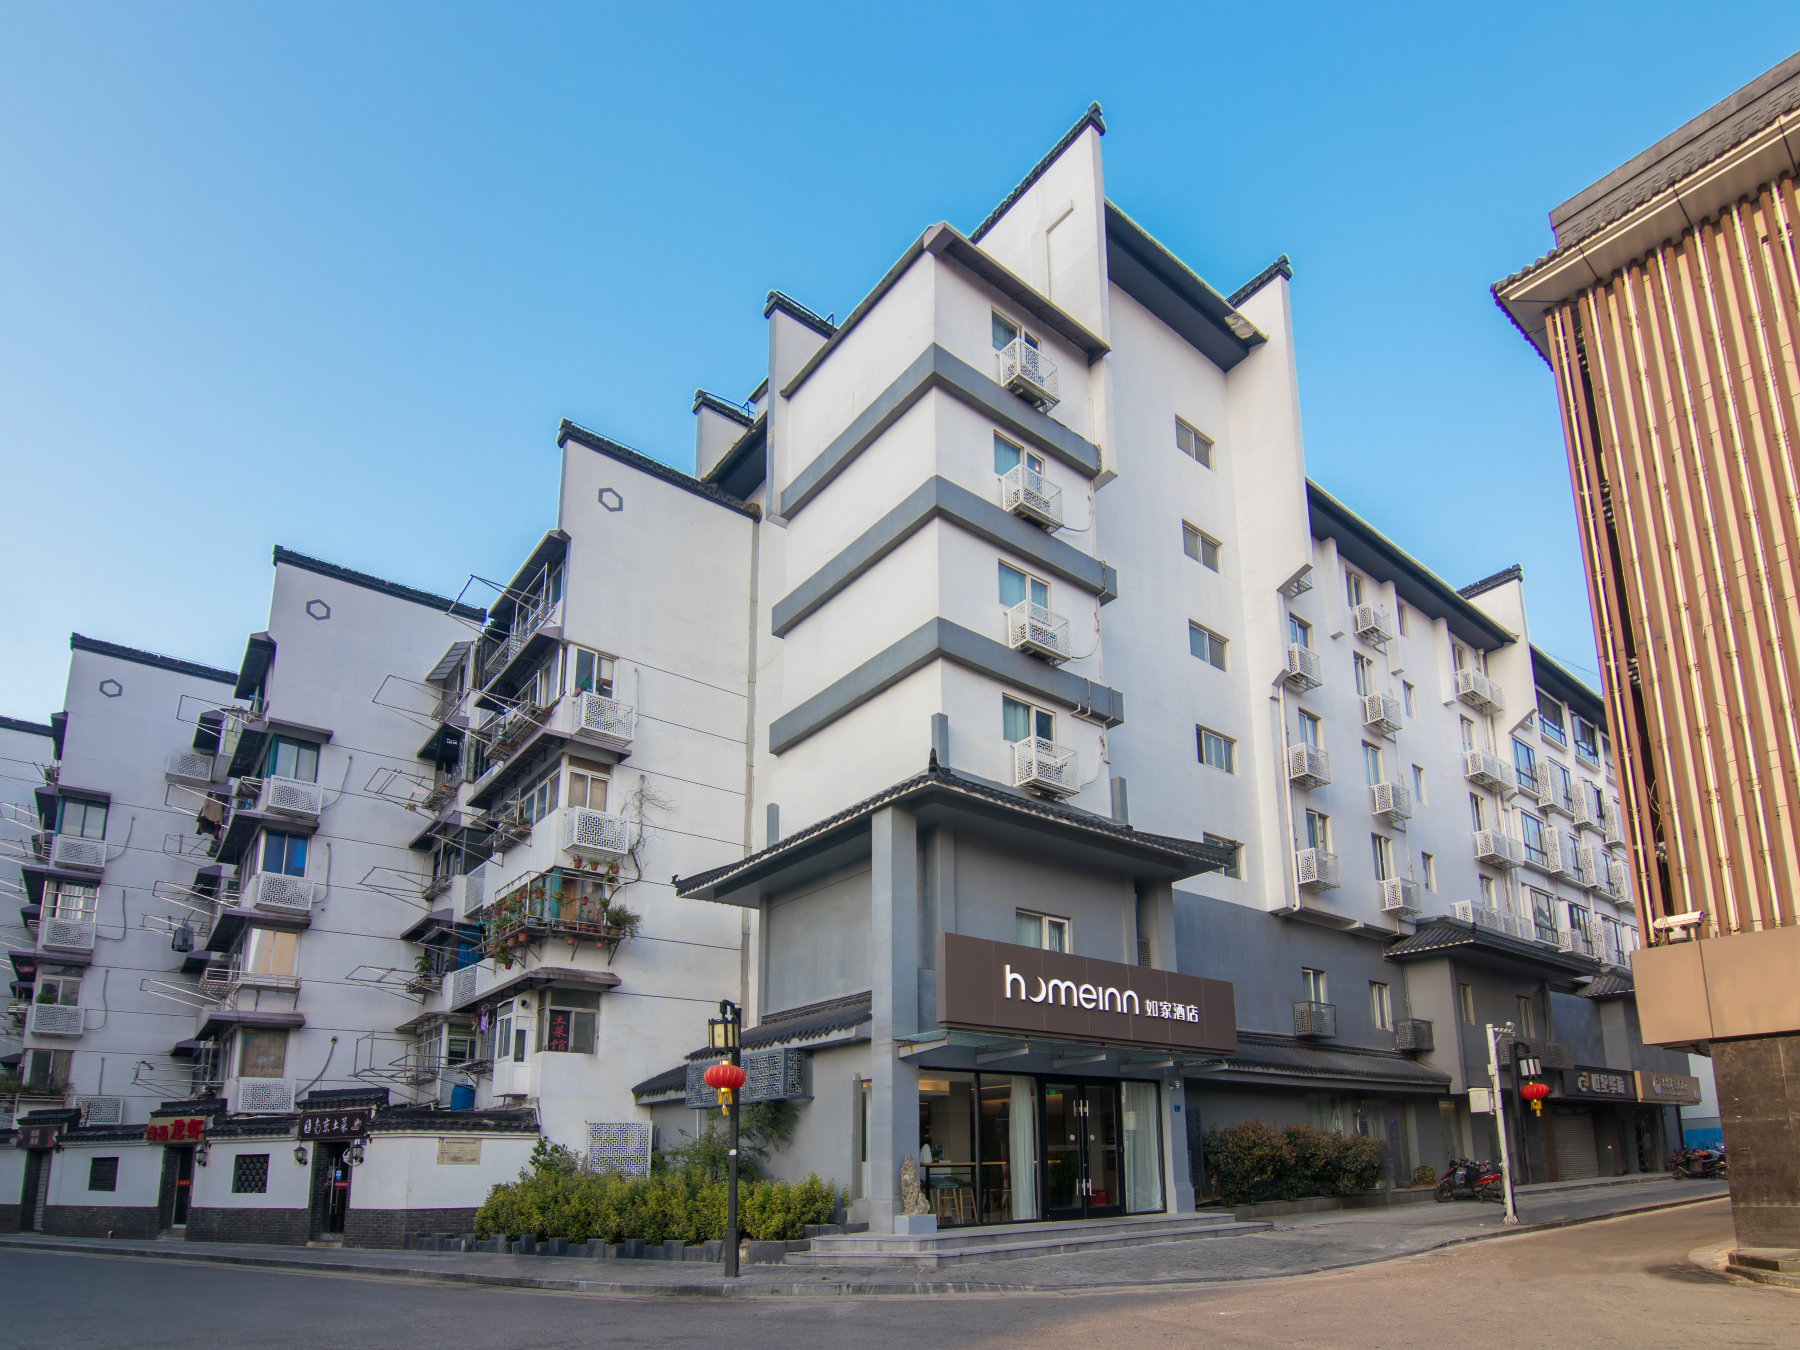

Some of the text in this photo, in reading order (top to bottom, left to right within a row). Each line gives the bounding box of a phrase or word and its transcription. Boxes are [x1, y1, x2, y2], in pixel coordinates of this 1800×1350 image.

[1144, 999, 1199, 1023] 如家酒店
[550, 1015, 567, 1051] 土菜馆
